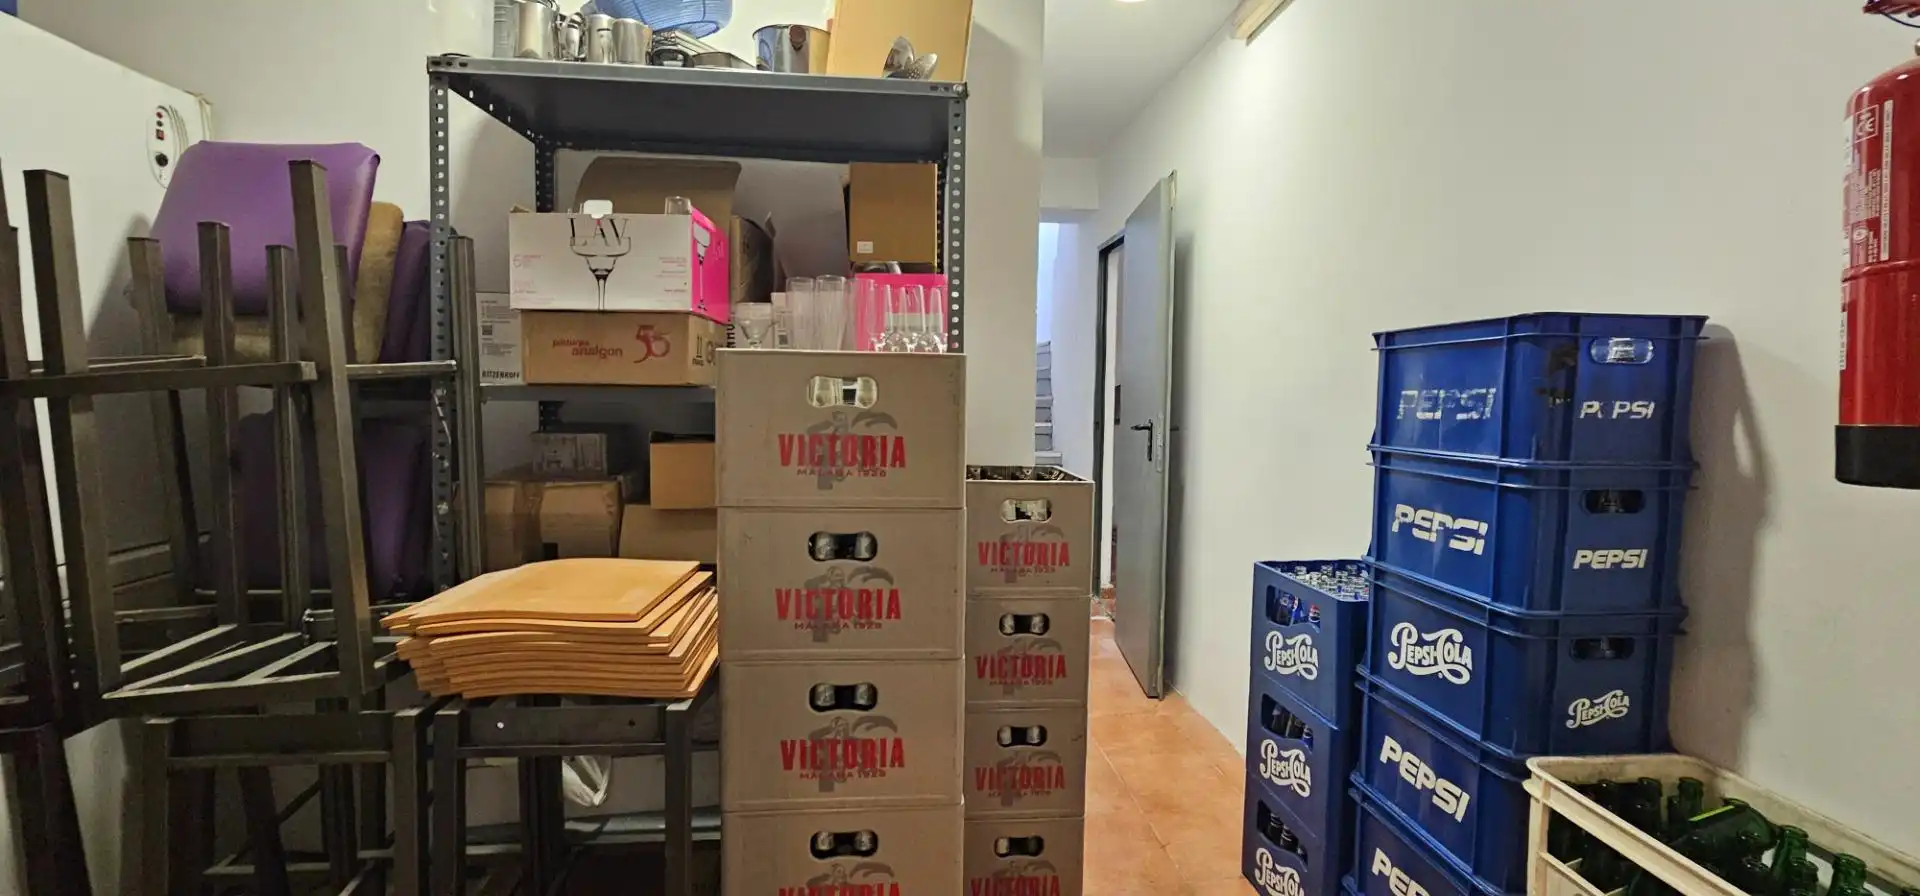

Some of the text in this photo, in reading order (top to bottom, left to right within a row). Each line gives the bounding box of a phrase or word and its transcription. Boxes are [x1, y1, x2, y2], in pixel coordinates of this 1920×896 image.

[1396, 387, 1497, 420] PEPSI
[1579, 400, 1656, 419] PPSI
[777, 433, 906, 468] VICTORIA
[1391, 503, 1489, 556] PEPSI
[977, 541, 1070, 567] VICTORIA
[1572, 549, 1649, 569] PEPSI
[774, 587, 902, 620] VICTORIA
[974, 653, 1067, 679] VICTORIA
[780, 737, 905, 771] VICTORIA
[973, 764, 1066, 791] VICTORIA
[1379, 735, 1470, 824] PEPSI
[1371, 847, 1430, 896] PEP
